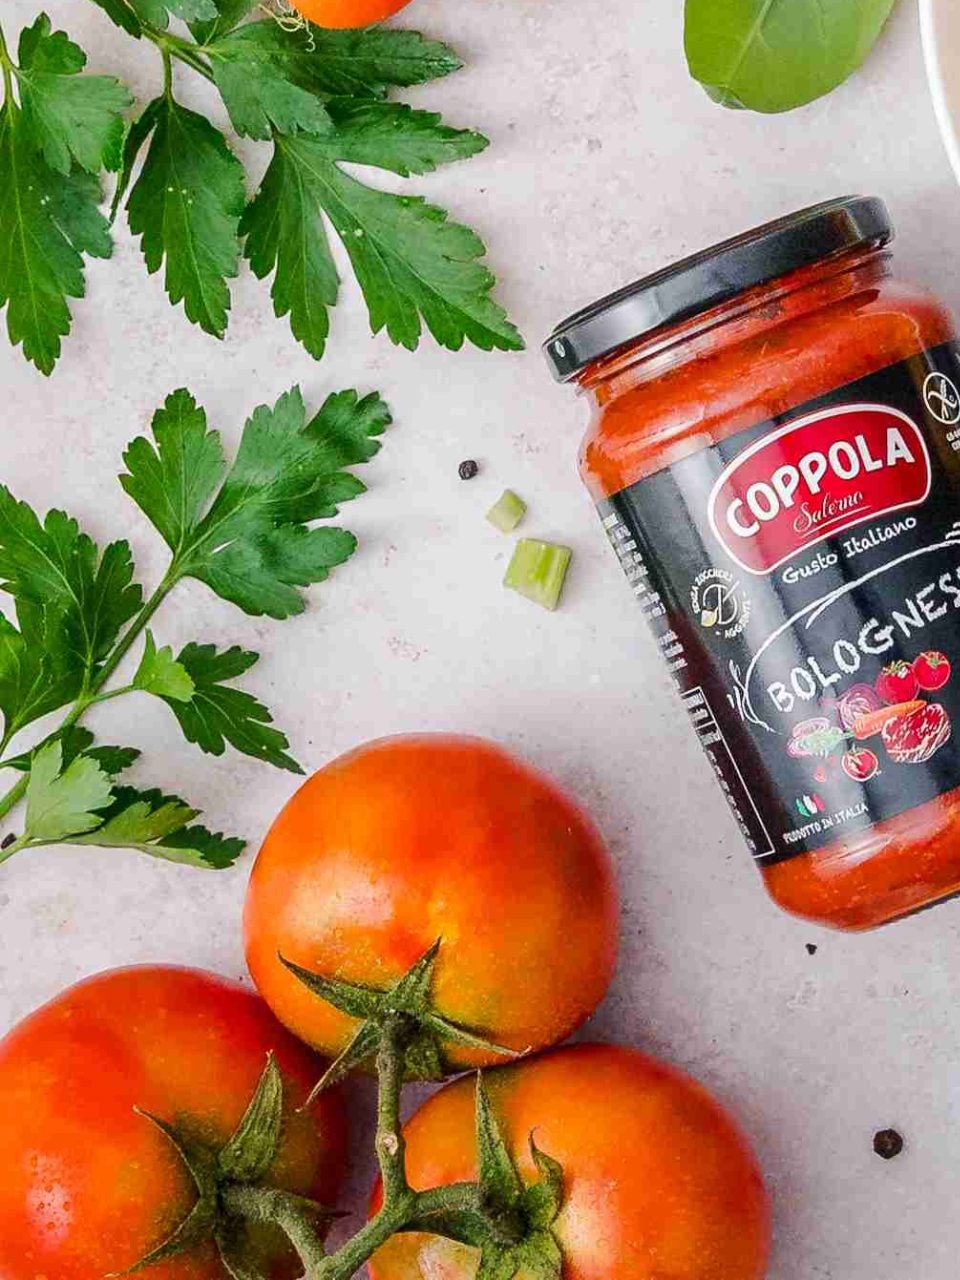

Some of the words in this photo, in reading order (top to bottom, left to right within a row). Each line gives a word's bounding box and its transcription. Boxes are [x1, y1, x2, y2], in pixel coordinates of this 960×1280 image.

[726, 427, 916, 538] COPPOLA
[793, 490, 864, 533] Salerno
[782, 552, 838, 584] Gusto
[842, 516, 917, 558] Italiano
[821, 816, 834, 830] IN
[834, 801, 869, 824] ITALIA
